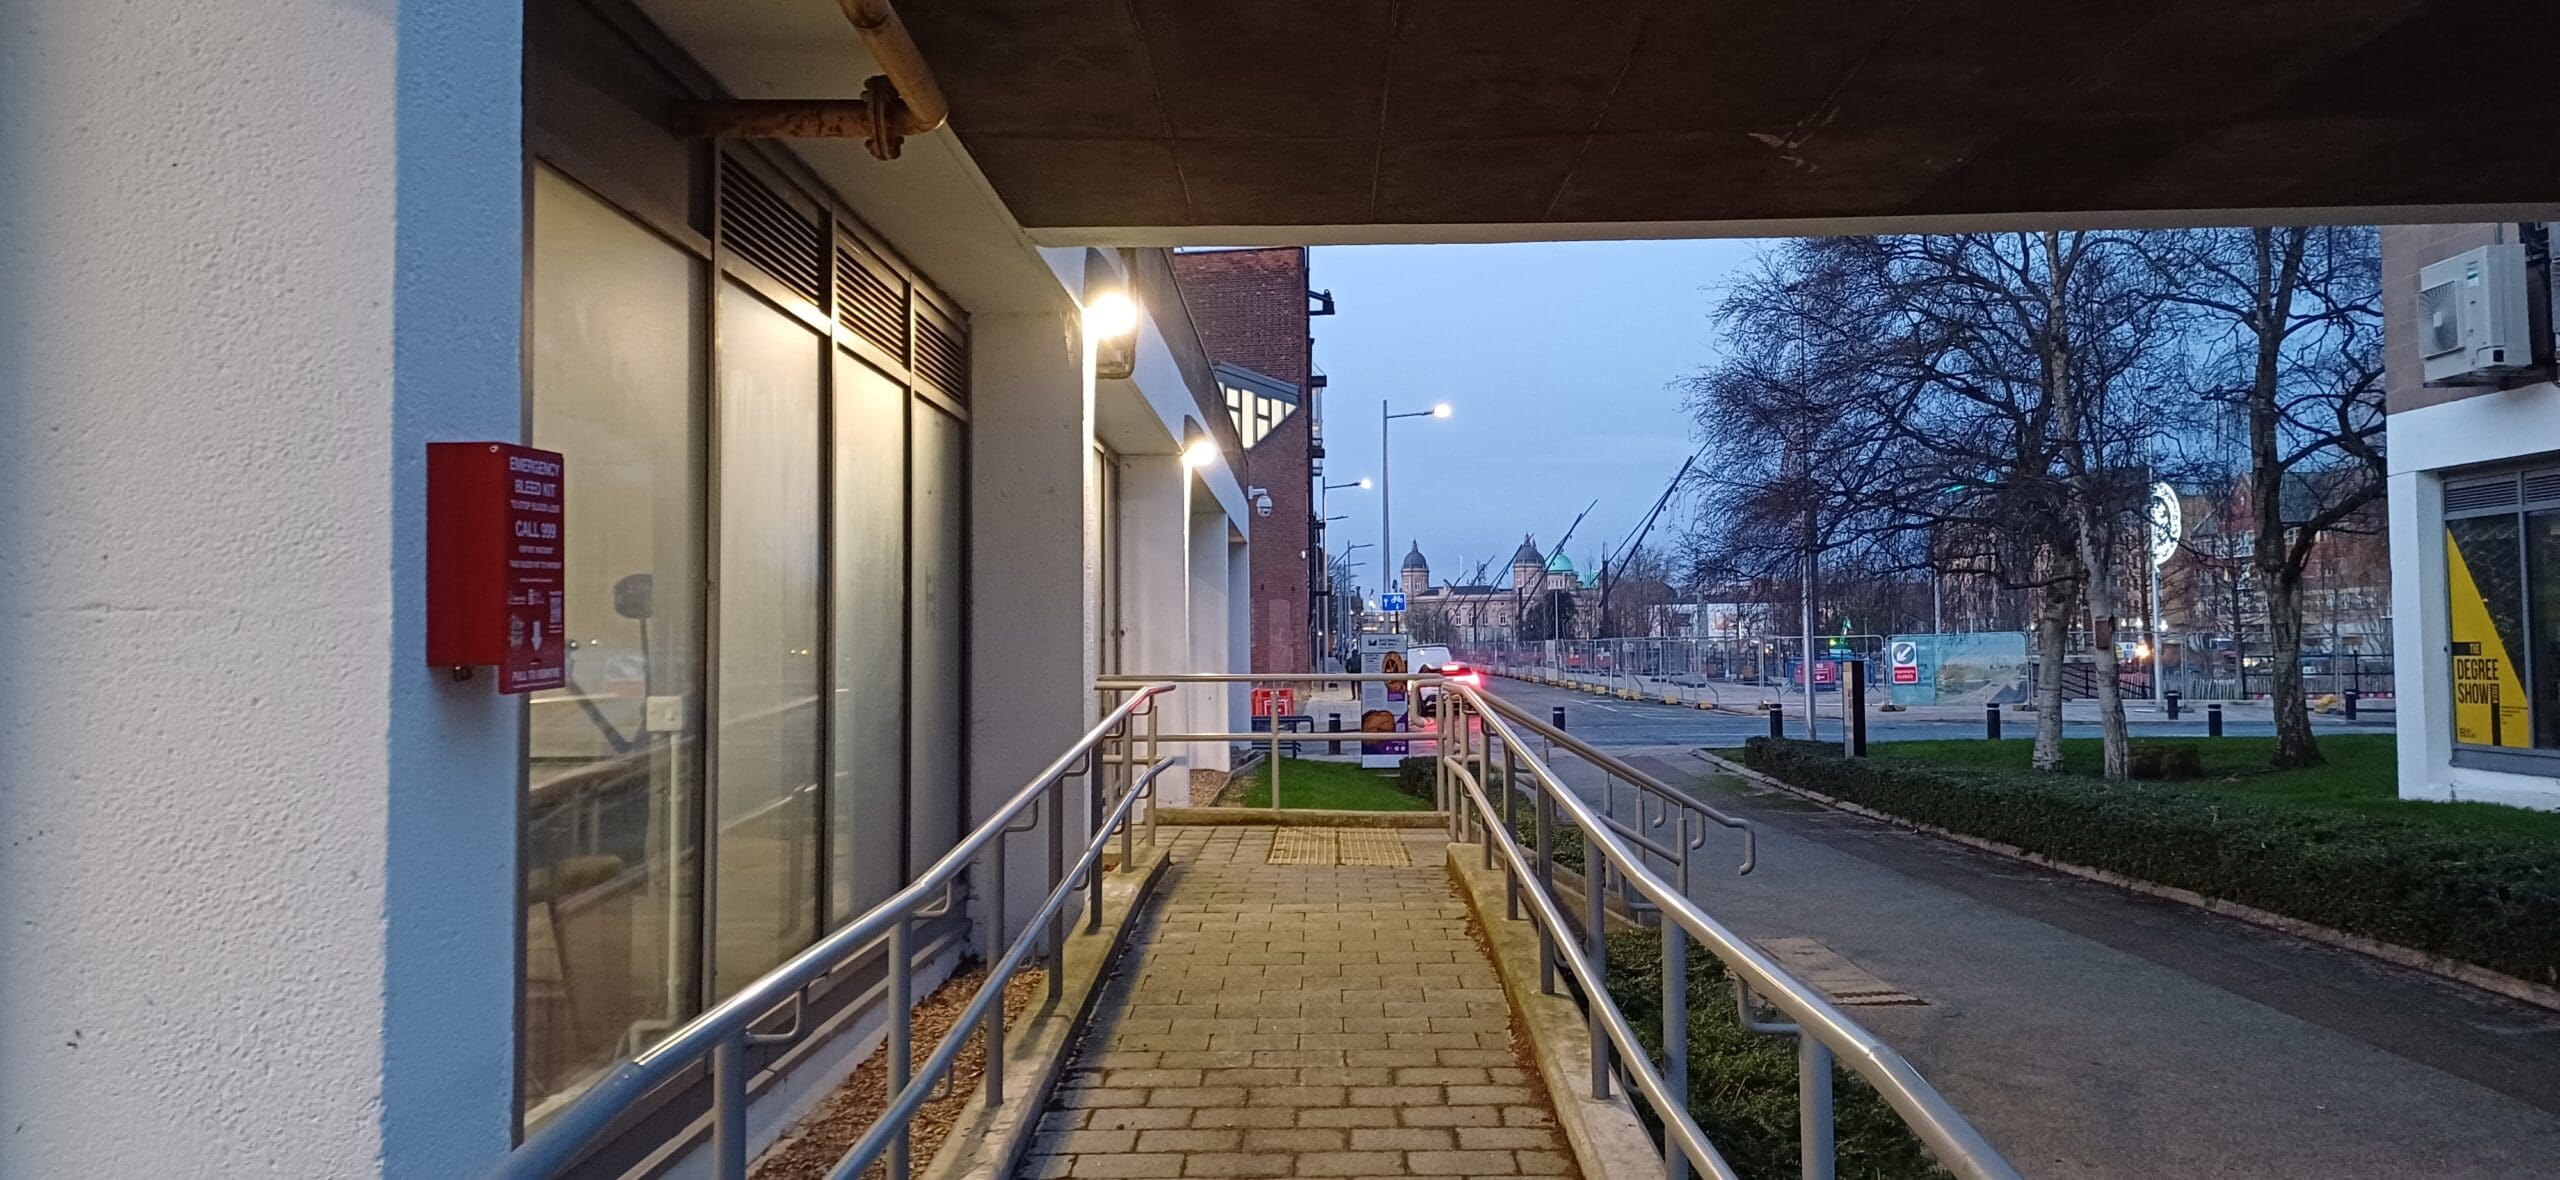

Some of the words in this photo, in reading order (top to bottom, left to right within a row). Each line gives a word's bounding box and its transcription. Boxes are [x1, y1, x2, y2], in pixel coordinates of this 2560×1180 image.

[510, 456, 560, 477] EMERGENCY
[515, 479, 541, 496] BLEED
[543, 483, 557, 497] KIT
[515, 520, 540, 538] CALL
[541, 523, 556, 539] 999
[2470, 643, 2480, 654] THE
[2457, 659, 2498, 680] DEGREE
[2458, 682, 2489, 704] SHOW
